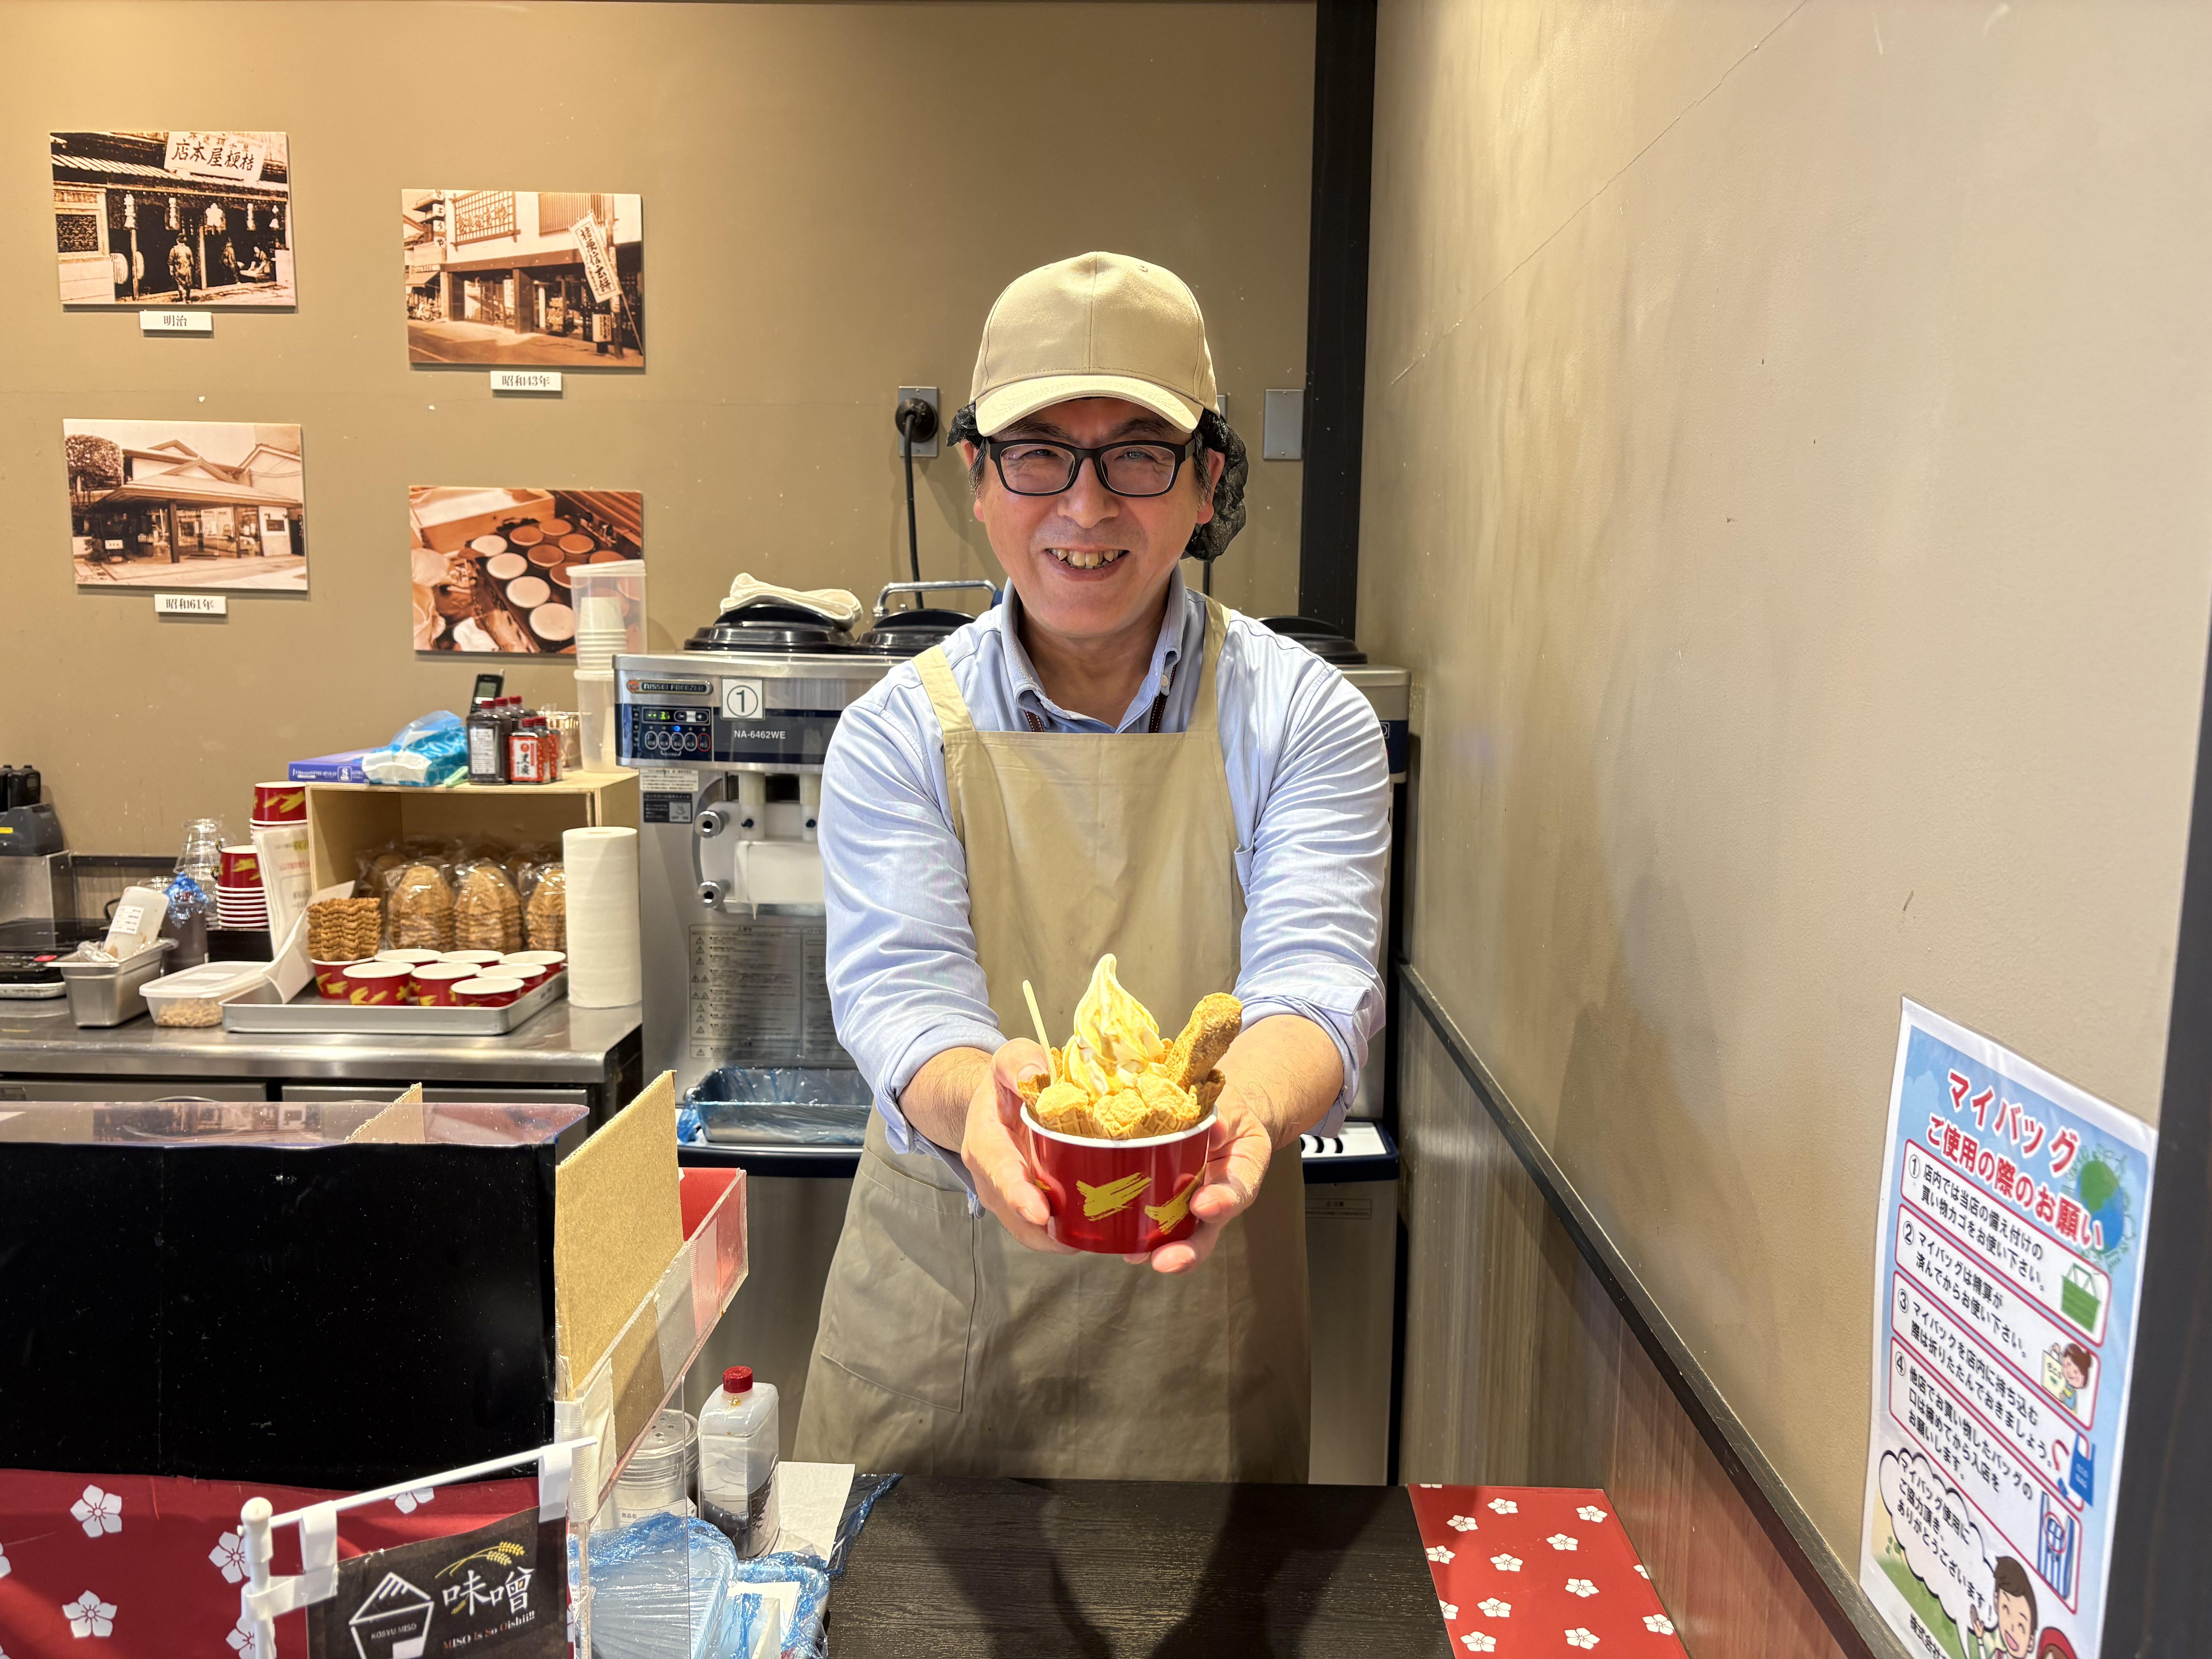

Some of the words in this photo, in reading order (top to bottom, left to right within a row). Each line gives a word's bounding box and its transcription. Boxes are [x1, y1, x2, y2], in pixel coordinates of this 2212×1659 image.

[163, 315, 187, 326] 明治
[502, 375, 550, 387] 昭和43年
[166, 598, 214, 610] 昭和61年
[734, 730, 786, 739] NA-6462WE
[1949, 1071, 2079, 1173] マイバッグ
[1927, 1115, 2102, 1248] ご使用の際のお願い
[1921, 1185, 2045, 1291] 買い物カゴをお使い下さい。
[1923, 1164, 2044, 1260] 店内では当店の備え付けの
[1918, 1231, 2003, 1309] マイバッグは精算が
[1916, 1251, 2026, 1358] 済んでからお使い下さい。
[1908, 1409, 1964, 1480] お願いします。
[441, 1566, 535, 1616] 味噌
[398, 1623, 417, 1635] MISO
[1910, 1613, 1946, 1659] 株式会社
